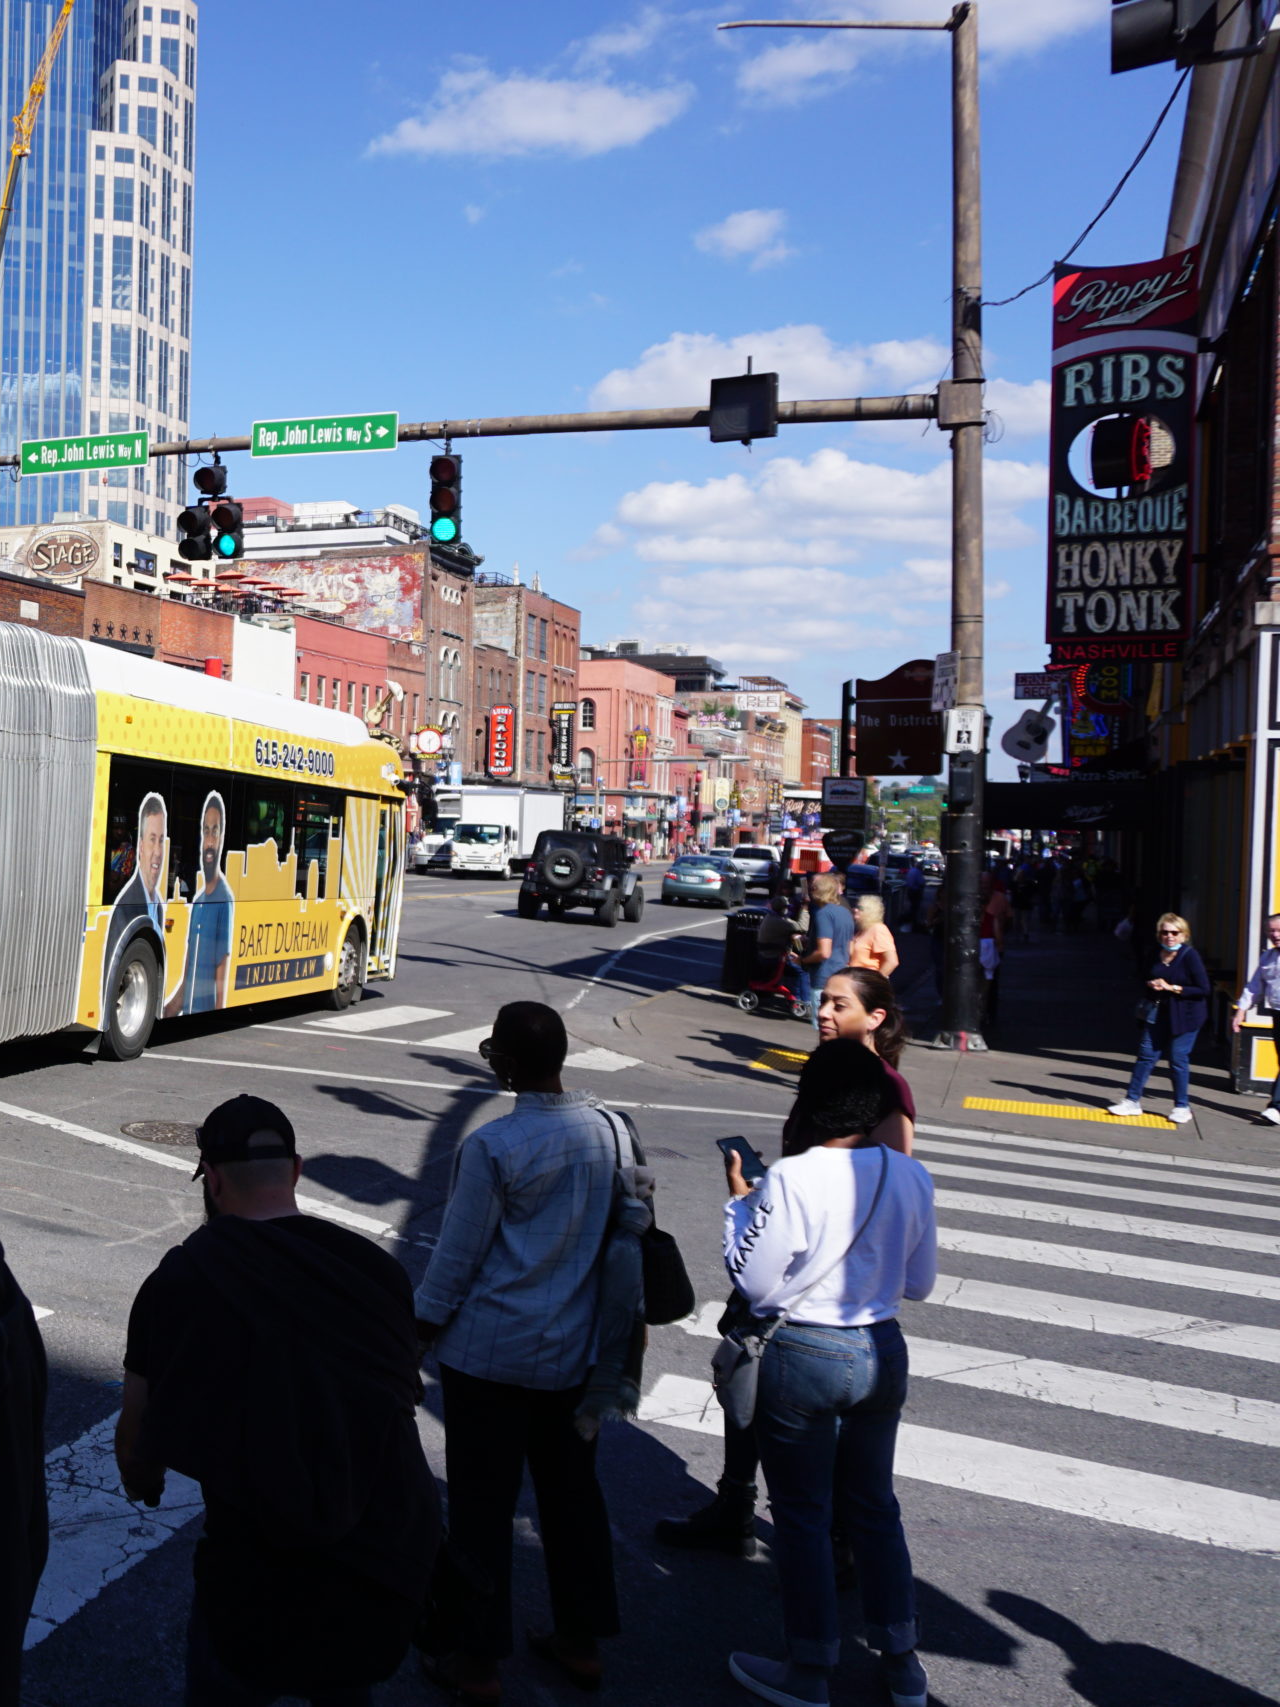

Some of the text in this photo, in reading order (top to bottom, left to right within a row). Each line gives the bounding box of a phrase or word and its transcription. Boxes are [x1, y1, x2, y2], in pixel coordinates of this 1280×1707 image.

[1058, 253, 1194, 322] Rippy's
[1062, 353, 1187, 408] RIBS
[86, 439, 115, 461] Lewis
[118, 444, 132, 461] Way
[134, 439, 142, 458] N
[310, 422, 343, 445] Lewis
[346, 426, 362, 445] Way
[363, 421, 372, 443] S
[1054, 484, 1188, 537] BARBEQUE
[32, 541, 96, 571] STAGE
[1056, 538, 1184, 589] HONKY
[1055, 588, 1182, 634] TONK
[1056, 642, 1179, 661] NASHVILLE
[494, 715, 508, 767] SALOON
[560, 713, 570, 765] WHISKEY
[860, 713, 939, 728] The District
[255, 737, 335, 778] 615-242-9000
[238, 920, 330, 958] BART DURHAM
[246, 959, 317, 985] INJURY LAW
